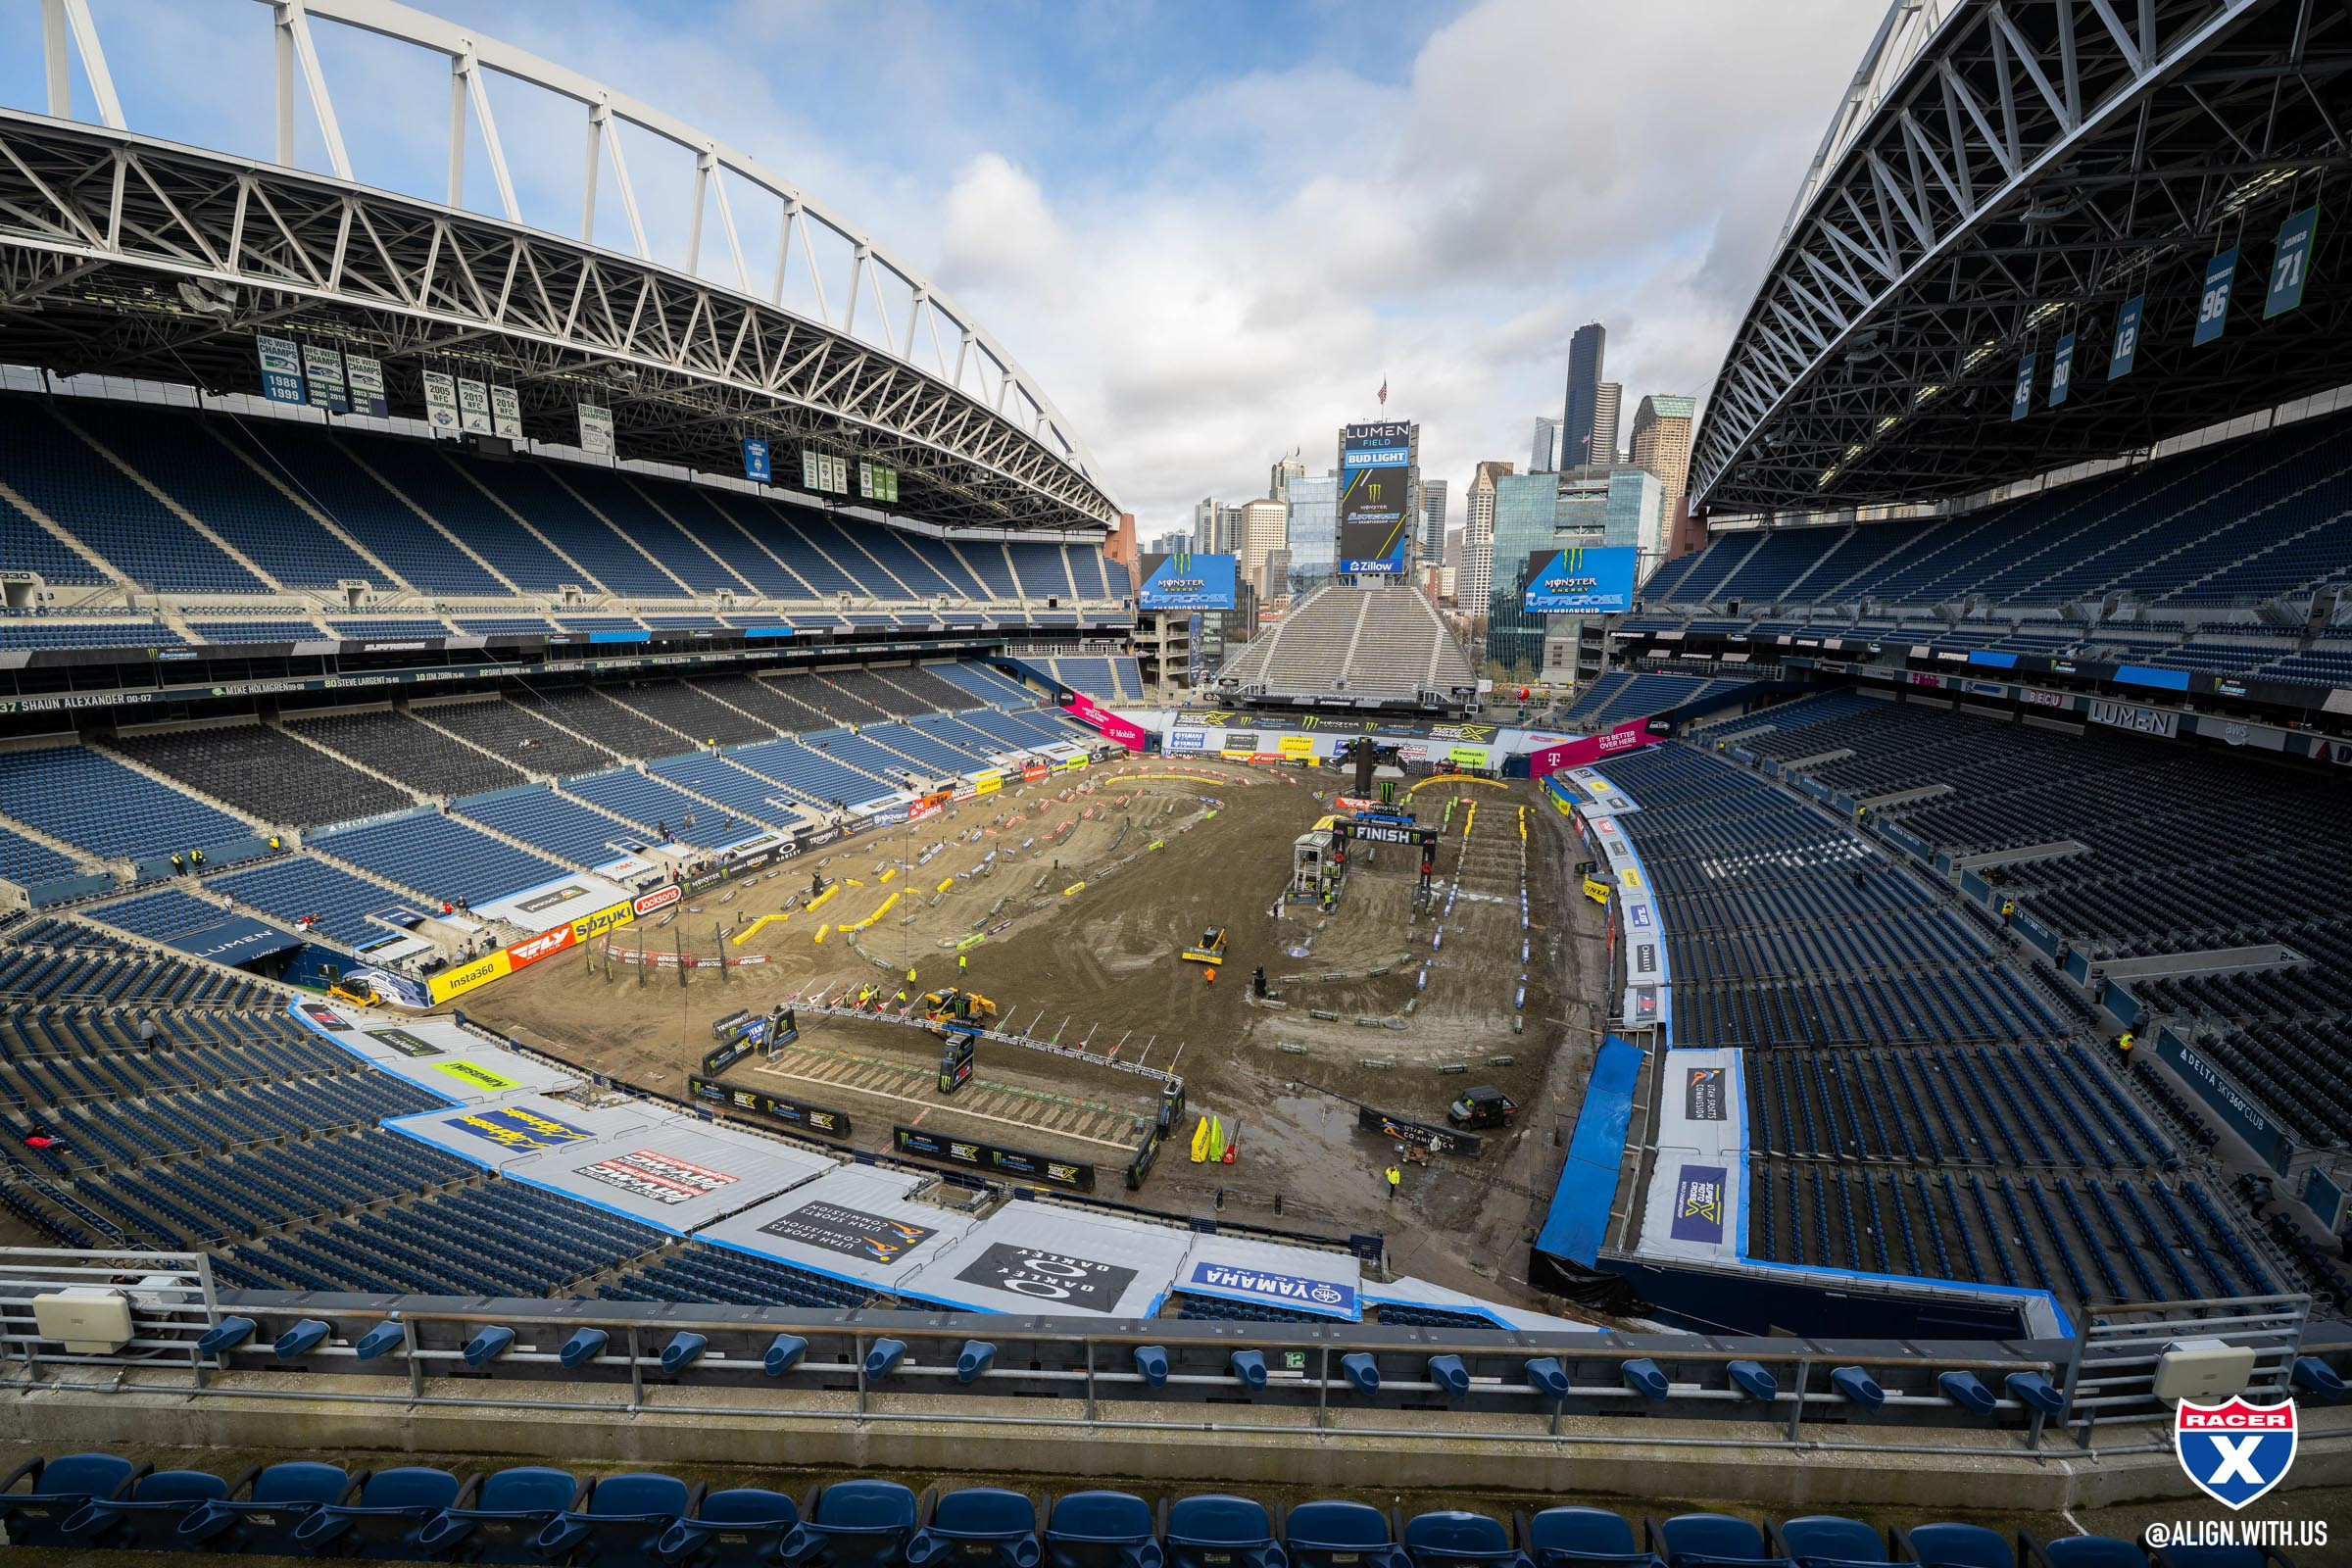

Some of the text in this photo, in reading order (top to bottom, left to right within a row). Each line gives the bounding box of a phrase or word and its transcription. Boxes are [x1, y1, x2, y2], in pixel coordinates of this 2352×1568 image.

[2281, 230, 2307, 250] JONES
[2207, 266, 2233, 285] KENNEDY
[2274, 249, 2304, 293] 71
[2200, 284, 2229, 323] 96
[2123, 313, 2135, 324] FAN
[259, 336, 296, 350] AFC WEST
[2115, 328, 2135, 360] 12
[260, 345, 297, 359] CHAMPS
[319, 350, 339, 360] WEST
[306, 354, 340, 368] CHAMPS
[347, 356, 380, 368] NFC WEST
[348, 363, 381, 375] CHAMPS
[2052, 360, 2070, 389] 80
[270, 375, 297, 388] 1988
[270, 387, 299, 400] 1999
[429, 384, 451, 396] 2005
[2015, 378, 2031, 405] 45
[433, 394, 449, 403] NFC
[464, 392, 483, 403] 2013
[496, 399, 514, 409] 2014
[426, 400, 457, 410] CHAMPIONS
[461, 408, 489, 416] CHAMPIONS
[594, 408, 611, 416] WORLD
[580, 412, 612, 422] CHAMPIONS
[1347, 424, 1409, 439] LUMEN
[1363, 438, 1391, 447] FIELD
[1348, 452, 1405, 464] BUD LIGHT
[1360, 562, 1394, 571] Zillow
[1544, 577, 1597, 588] MONSTER
[324, 679, 337, 688] 80
[358, 676, 385, 685] LARGENT
[425, 672, 437, 681] JIM
[437, 671, 453, 680] ZORN
[225, 683, 289, 695] MIKE HOLMGREN
[0, 694, 152, 712] 37 SHAUN ALEXANDER 00-07
[2030, 691, 2062, 707] BECU
[2091, 702, 2171, 735] LUMEN
[1115, 729, 1136, 739] Mobile
[1612, 730, 1636, 741] BETTER
[2225, 722, 2248, 736] aws
[1599, 741, 1618, 750] OVER
[1619, 737, 1637, 746] HERE
[576, 772, 596, 781] DELTA
[982, 780, 1001, 790] DUNLOP
[339, 818, 368, 829] DELTA
[1356, 826, 1409, 843] FINISH
[747, 854, 768, 866] amazon
[776, 850, 801, 862] OAKLEY
[692, 872, 720, 888] MONSTER
[527, 896, 562, 910] peacock
[639, 885, 680, 911] Jacksons
[575, 906, 631, 938] SUZUKI
[196, 930, 271, 957] LUMEN
[514, 927, 570, 958] FLY
[251, 947, 280, 959] LUMEN
[526, 944, 563, 960] RACING
[450, 964, 494, 990] Insta360
[445, 1062, 508, 1088] Kawasaki
[2187, 1054, 2215, 1086] DELTA
[1695, 1084, 1704, 1119] COMMISSION
[1707, 1084, 1717, 1119] UTAH SPORTS
[1689, 1181, 1697, 1201] CROSS
[1705, 1182, 1714, 1203] SUPER
[800, 1208, 882, 1233] UTAH SPORTS
[808, 1203, 889, 1228] COMMISSION
[768, 1224, 854, 1250] UTAH SPORTS
[778, 1219, 862, 1245] COMMISSION
[1013, 1249, 1110, 1272] OAKLEY
[996, 1267, 1096, 1293] OAKLEY
[1206, 1269, 1309, 1298] YAMAHA
[1216, 1267, 1330, 1290] RACING
[1285, 1352, 1305, 1368] 12
